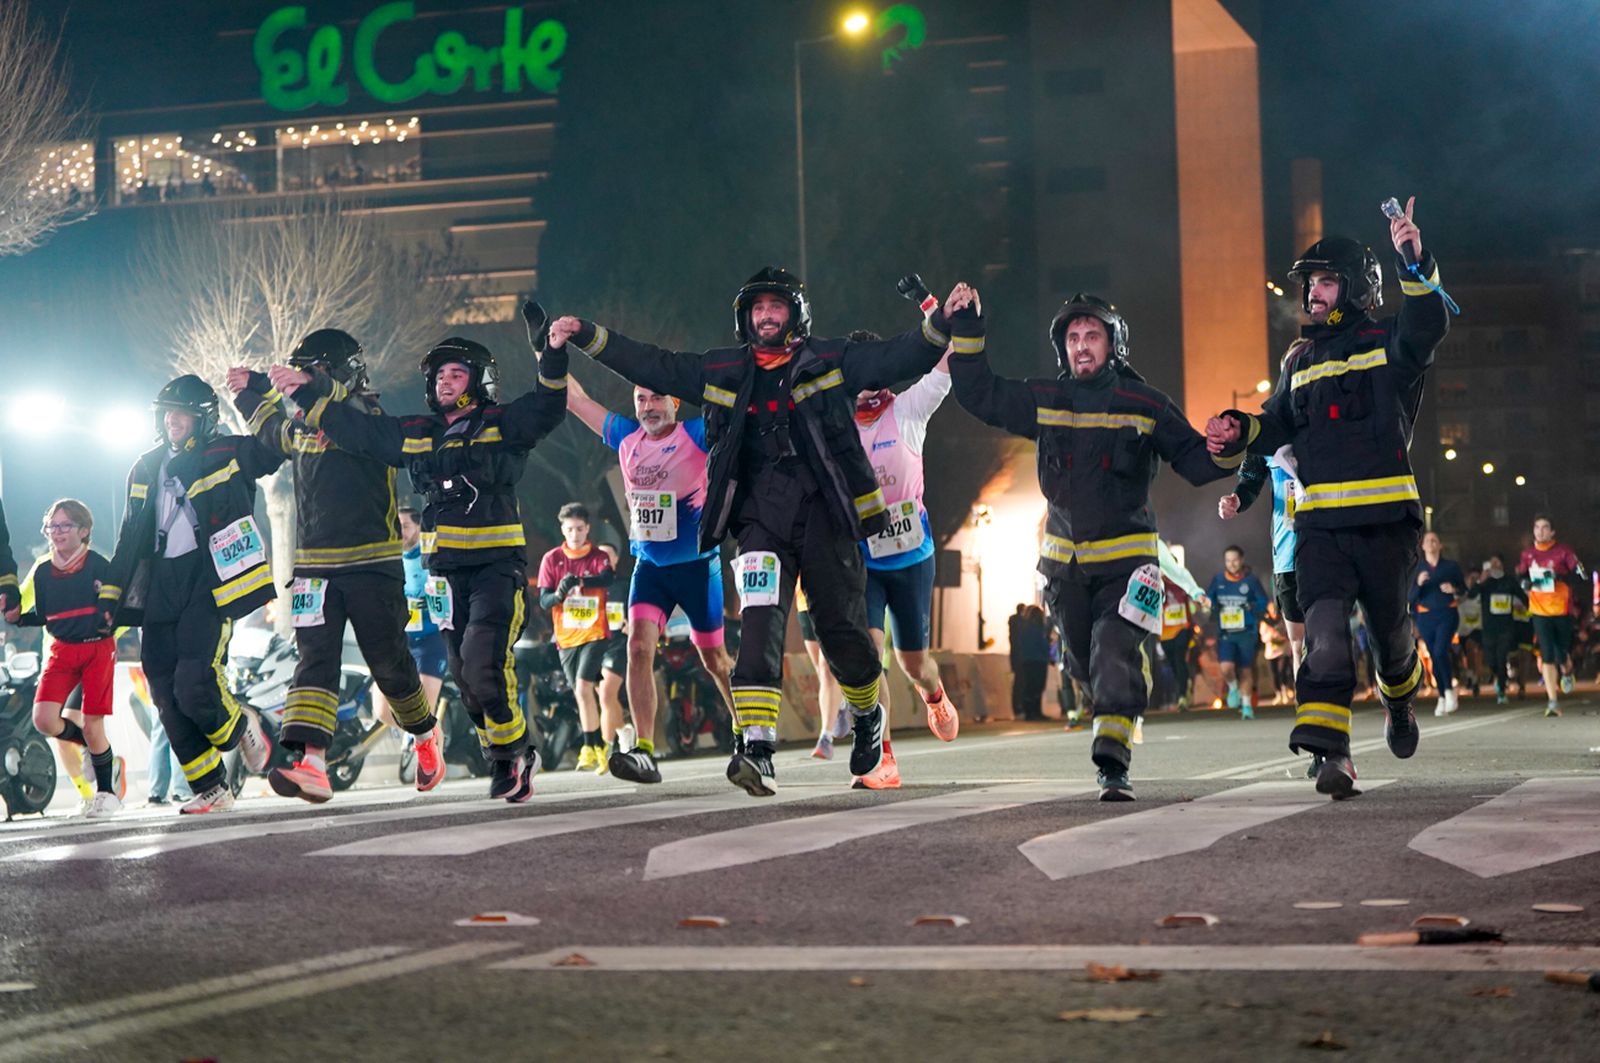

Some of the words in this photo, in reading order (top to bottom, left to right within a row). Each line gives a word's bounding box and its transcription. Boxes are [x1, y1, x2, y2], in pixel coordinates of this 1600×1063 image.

[254, 6, 347, 111] El
[354, 1, 568, 103] Corte
[637, 508, 665, 525] 3917
[221, 535, 253, 562] 9242
[1134, 585, 1160, 610] 932
